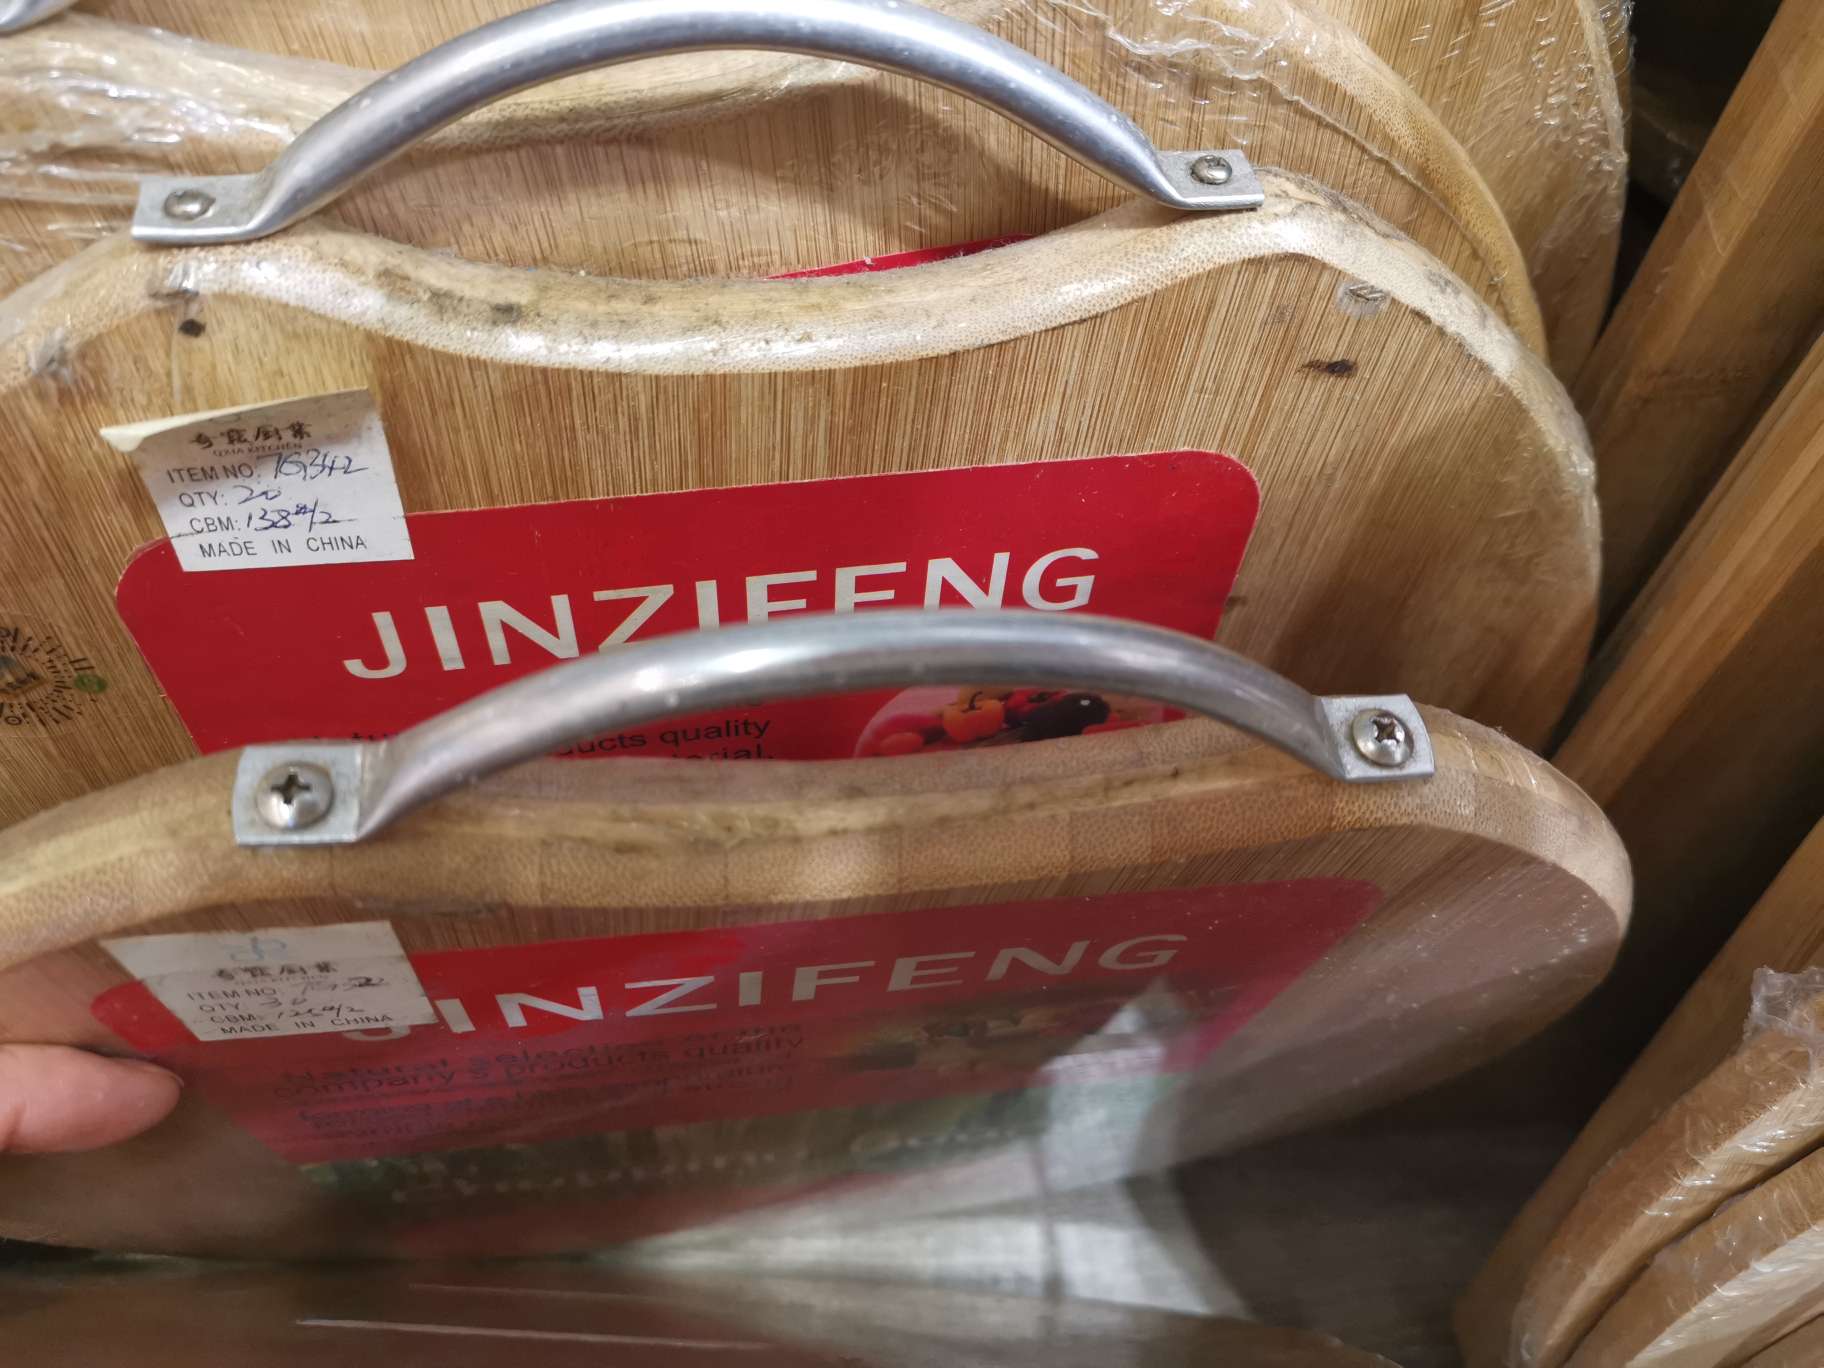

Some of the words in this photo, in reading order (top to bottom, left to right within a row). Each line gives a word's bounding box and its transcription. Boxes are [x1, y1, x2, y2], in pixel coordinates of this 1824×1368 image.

[167, 465, 220, 484] ITEM
[179, 489, 228, 508] QTY:
[189, 515, 241, 534] CBM:
[199, 540, 257, 558] MADE
[271, 537, 292, 554] IN
[306, 535, 368, 552] CHINA
[343, 547, 1100, 680] JINZIFENG
[659, 718, 772, 748] quality
[220, 1021, 280, 1035] MADE
[294, 1020, 316, 1030] IN
[330, 1012, 394, 1027] CHINA
